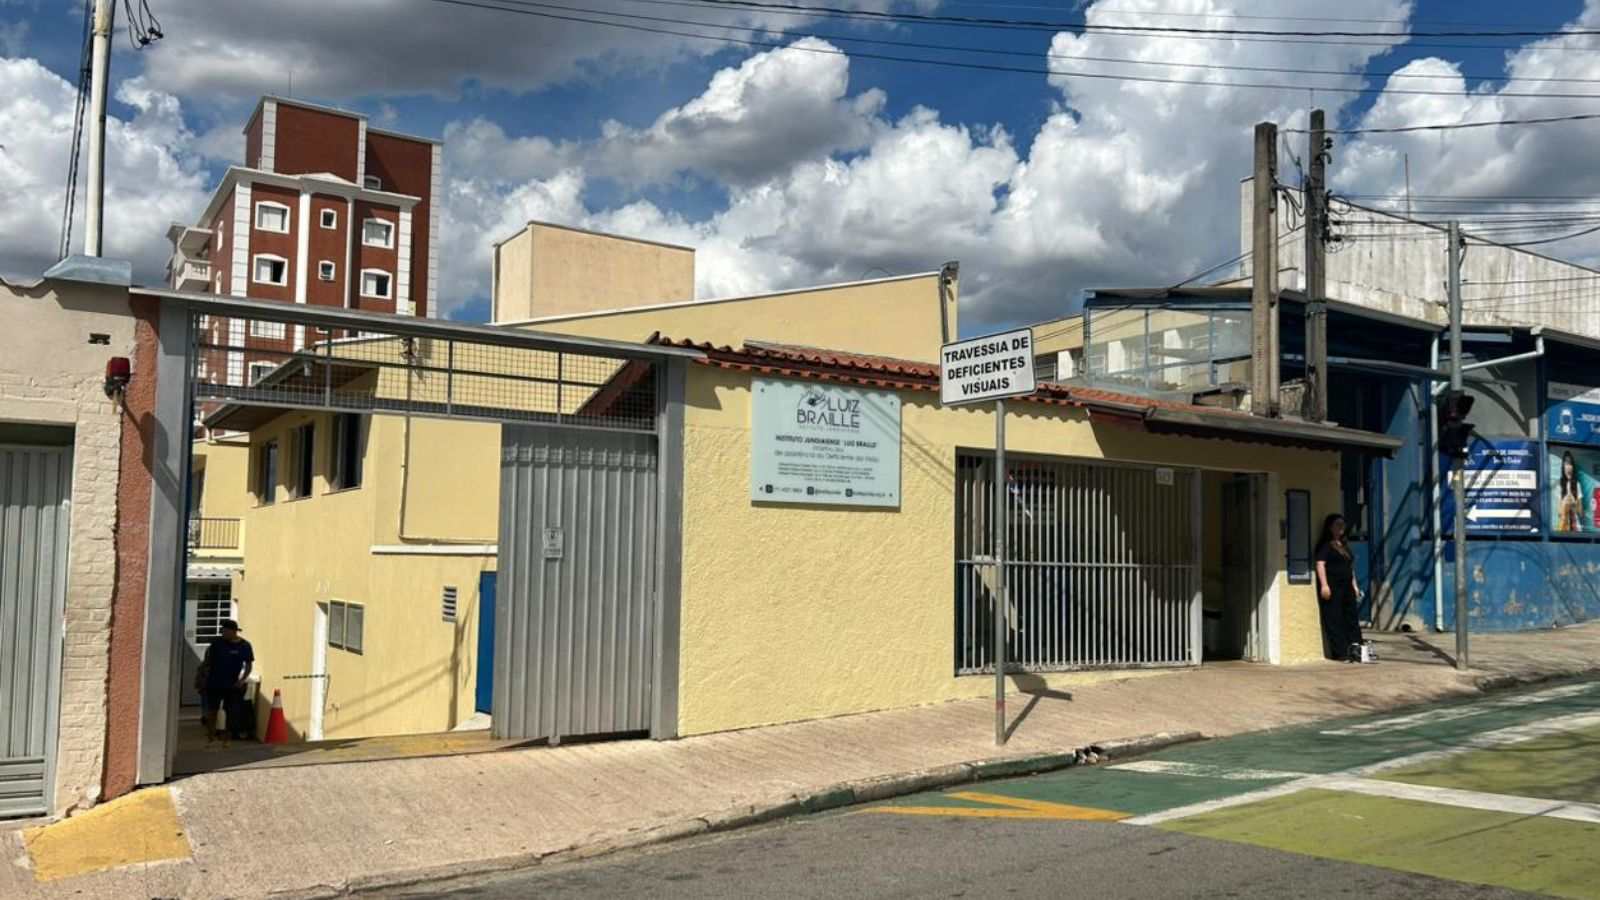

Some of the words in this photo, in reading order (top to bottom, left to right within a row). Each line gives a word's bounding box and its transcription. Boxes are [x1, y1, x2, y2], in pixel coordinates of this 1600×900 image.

[944, 341, 1009, 363] TRAVESSIA
[1012, 337, 1029, 350] DE
[948, 356, 1026, 380] DEFICIENTES
[962, 377, 1010, 395] VISUAIS
[827, 398, 860, 413] LUIZ
[796, 408, 860, 428] BRAILLE
